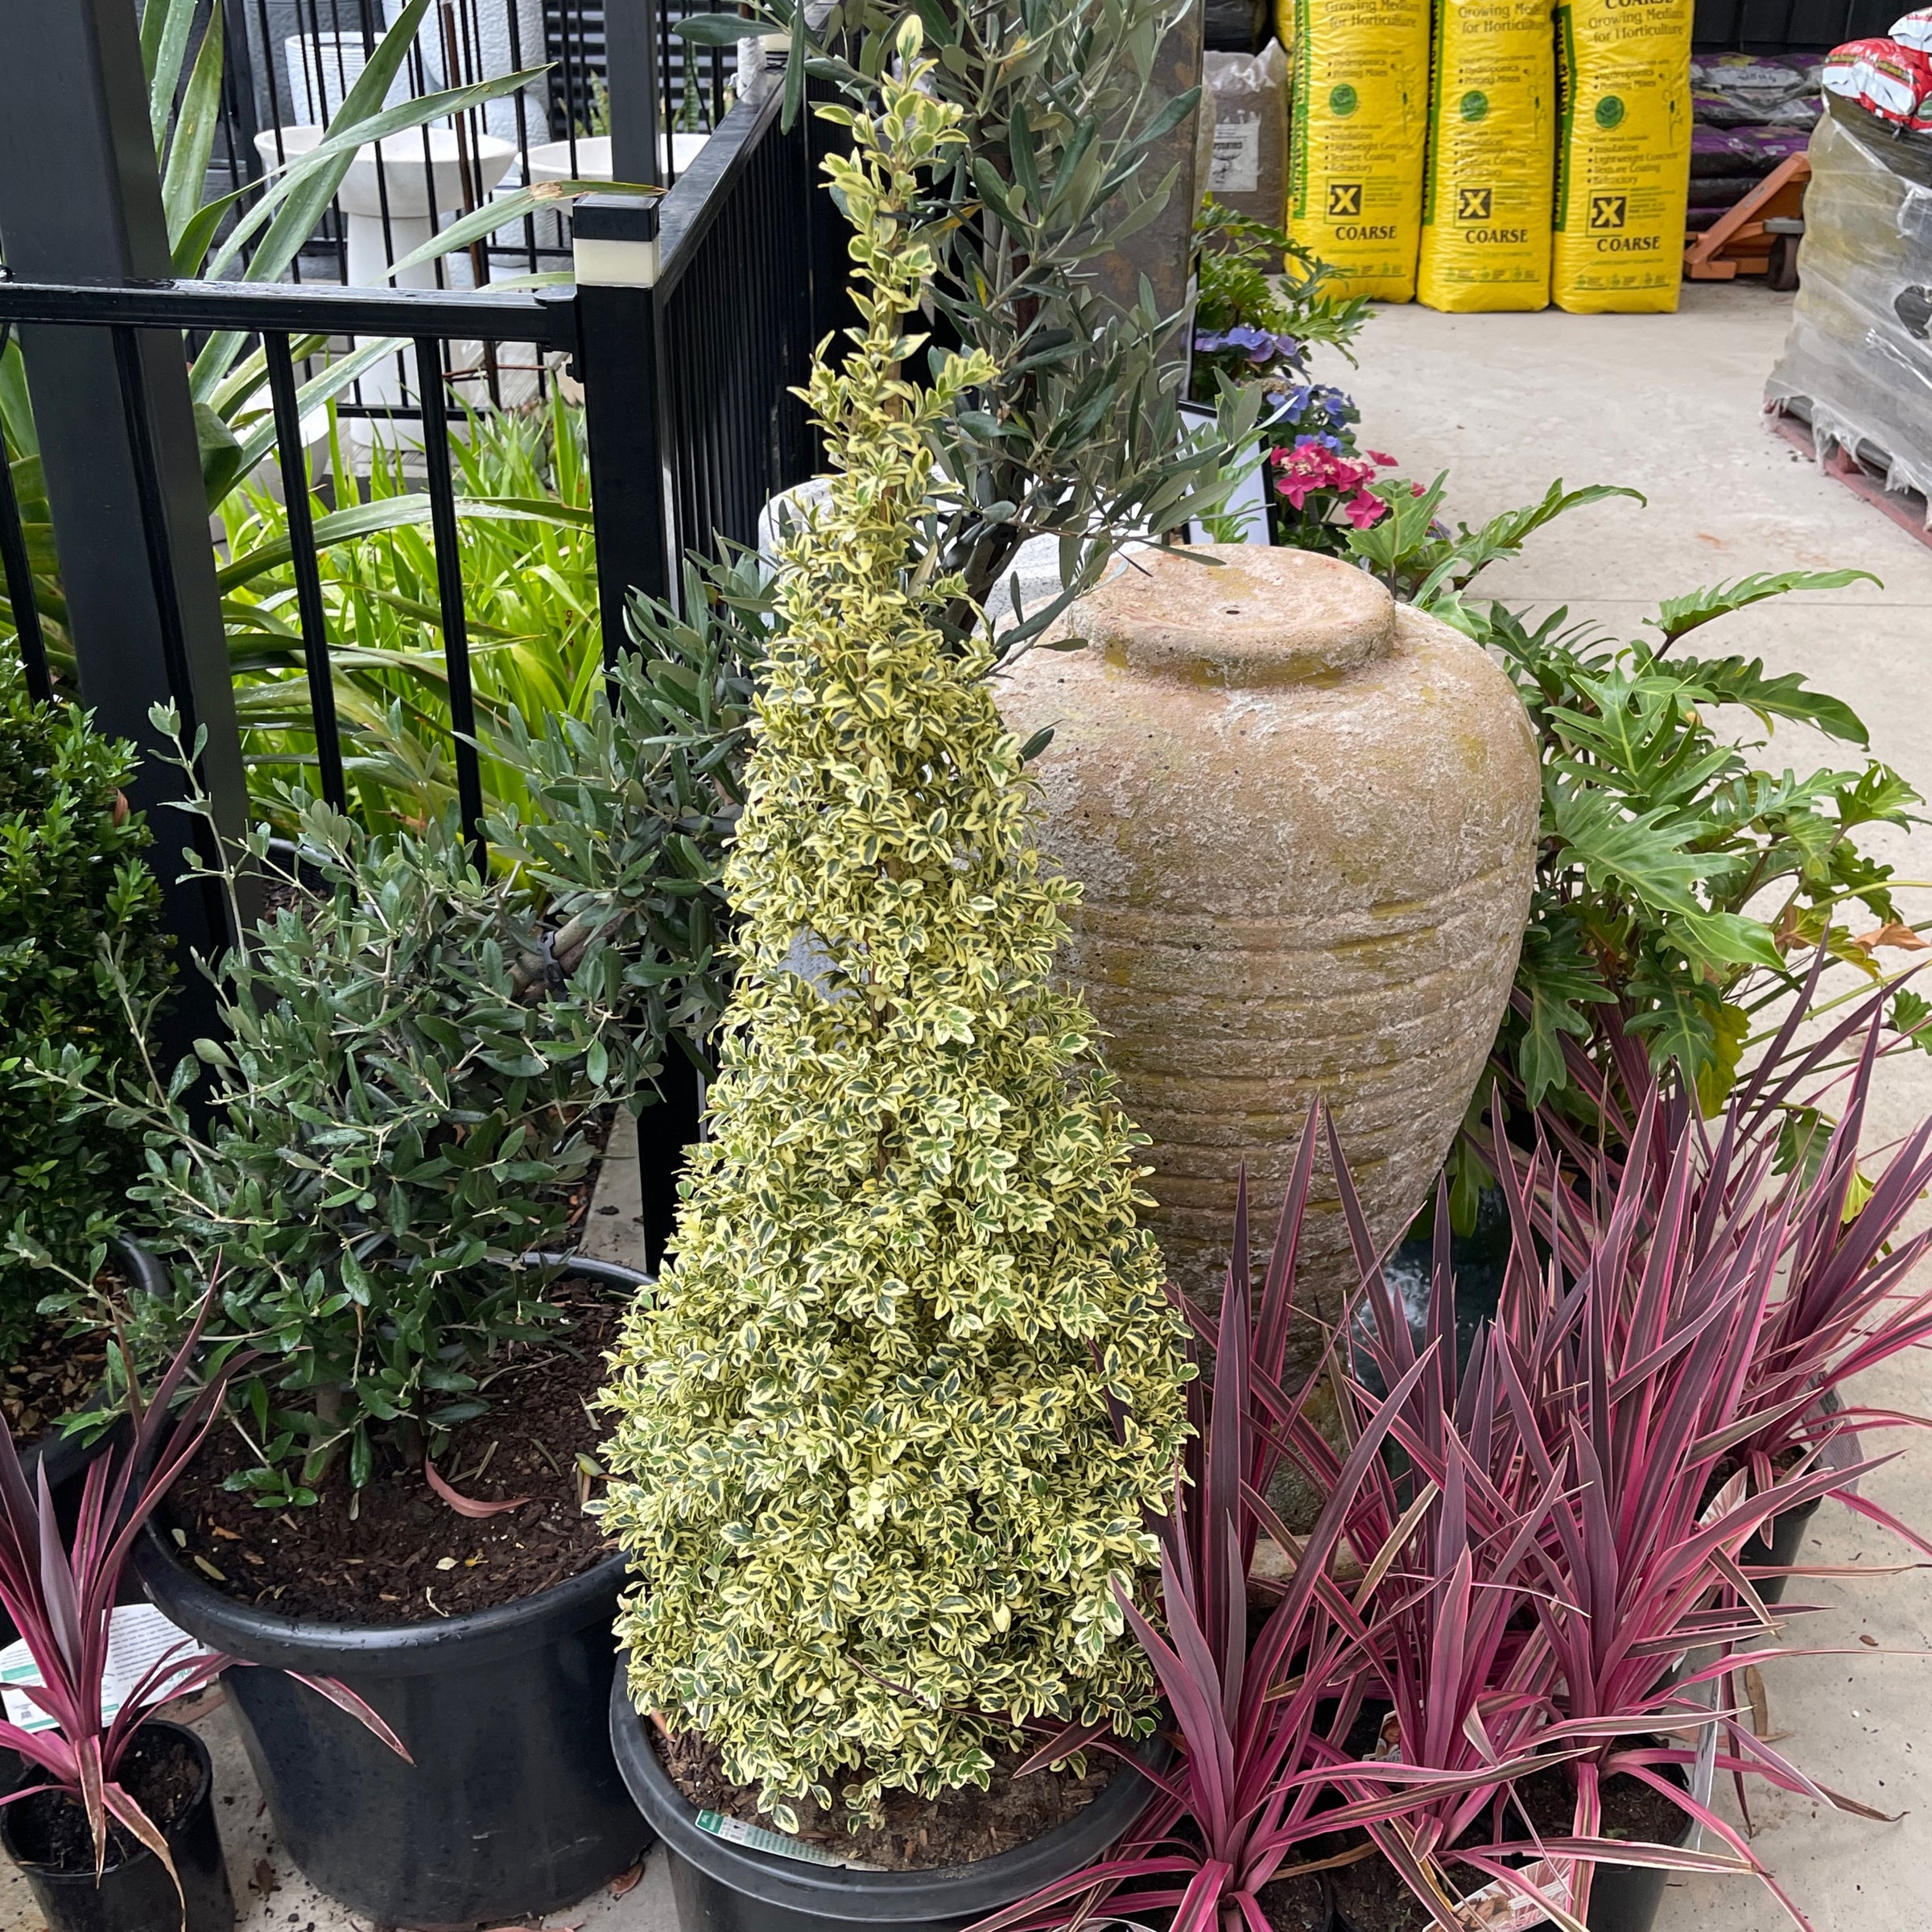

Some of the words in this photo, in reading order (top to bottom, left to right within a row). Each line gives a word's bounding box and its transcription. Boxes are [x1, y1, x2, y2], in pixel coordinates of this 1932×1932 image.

[1325, 1, 1377, 13] Growing
[1458, 4, 1510, 19] Growing
[1606, 0, 1674, 9] COARSE
[1330, 17, 1346, 27] for
[1352, 14, 1418, 27] Horticulture
[1588, 11, 1643, 28] Growing
[1646, 8, 1686, 20] Medium
[1463, 22, 1480, 34] for
[1594, 31, 1611, 43] for
[1615, 23, 1683, 39] Horticulture
[1594, 154, 1644, 165] Lightweight
[1335, 225, 1397, 241] COARSE
[1465, 229, 1528, 243] COARSE
[1596, 236, 1661, 252] COARSE
